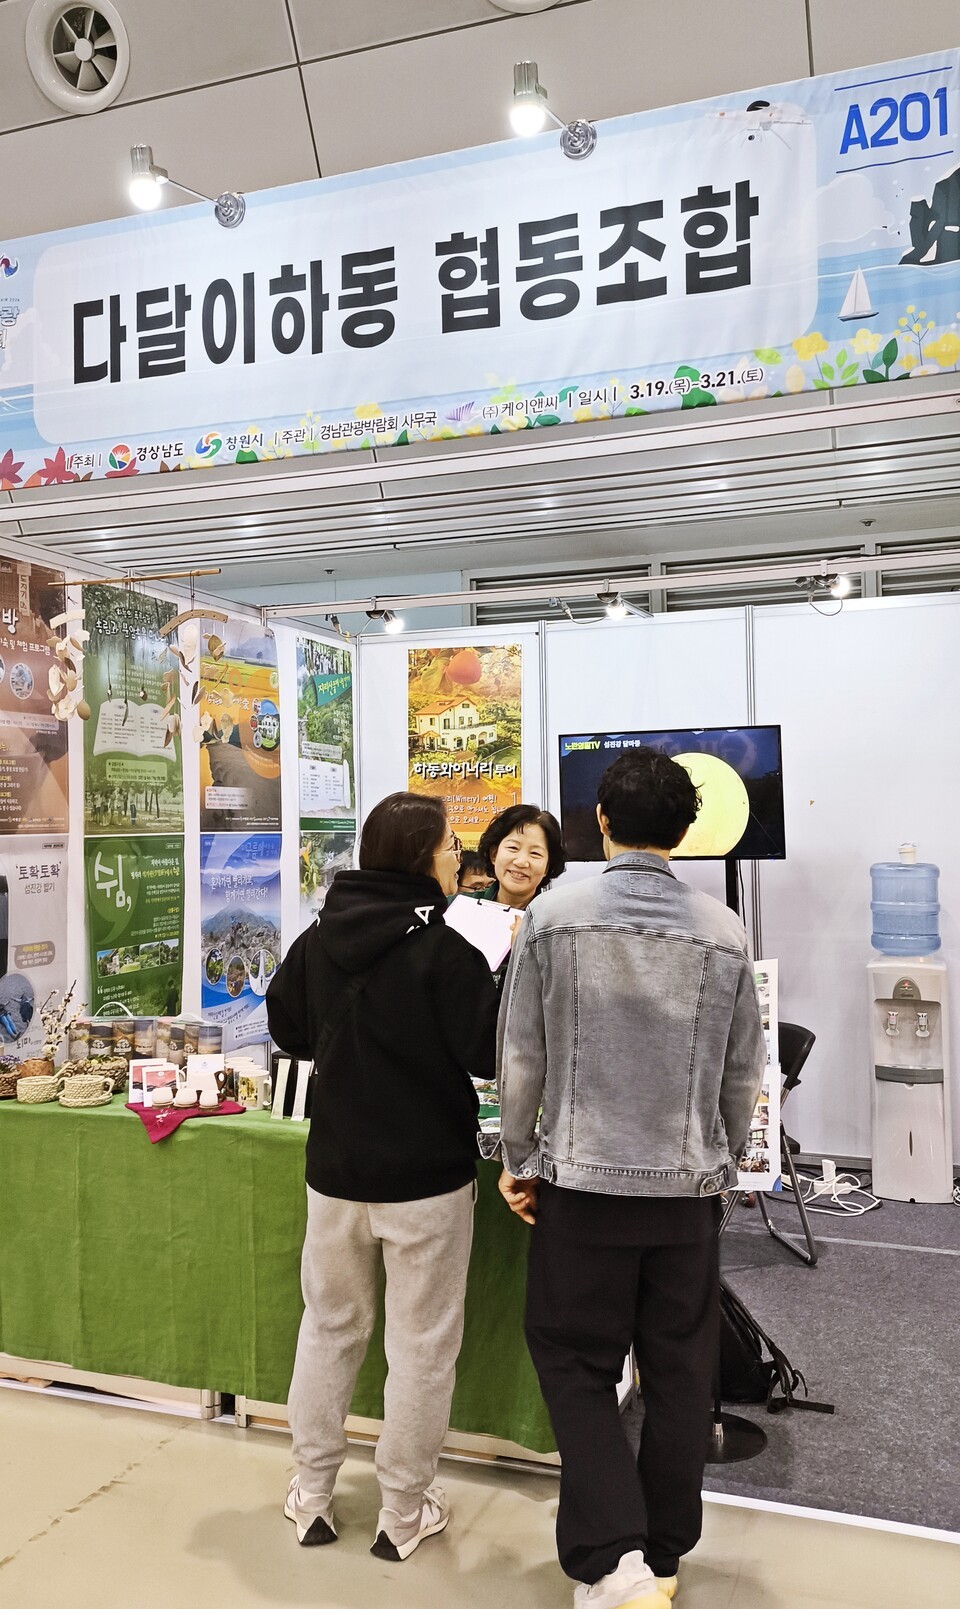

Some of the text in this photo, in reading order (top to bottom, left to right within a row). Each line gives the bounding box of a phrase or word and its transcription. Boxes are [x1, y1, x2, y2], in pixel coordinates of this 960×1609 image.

[839, 86, 948, 155] A201
[73, 179, 759, 385] 다달이하동 협동조합
[73, 453, 95, 469] 주최
[136, 442, 184, 462] 경상남도
[225, 433, 264, 450] 창원시
[282, 429, 307, 445] 주관
[320, 416, 399, 440] 경남관광박람회
[401, 411, 438, 429] 사무국
[578, 390, 607, 406] 일시
[629, 367, 764, 400] 3.19.(목)~3.21.(토)
[29, 642, 51, 656] 프로그램
[413, 761, 518, 780] 하동와이너리 투어
[94, 851, 132, 912] 쉼,
